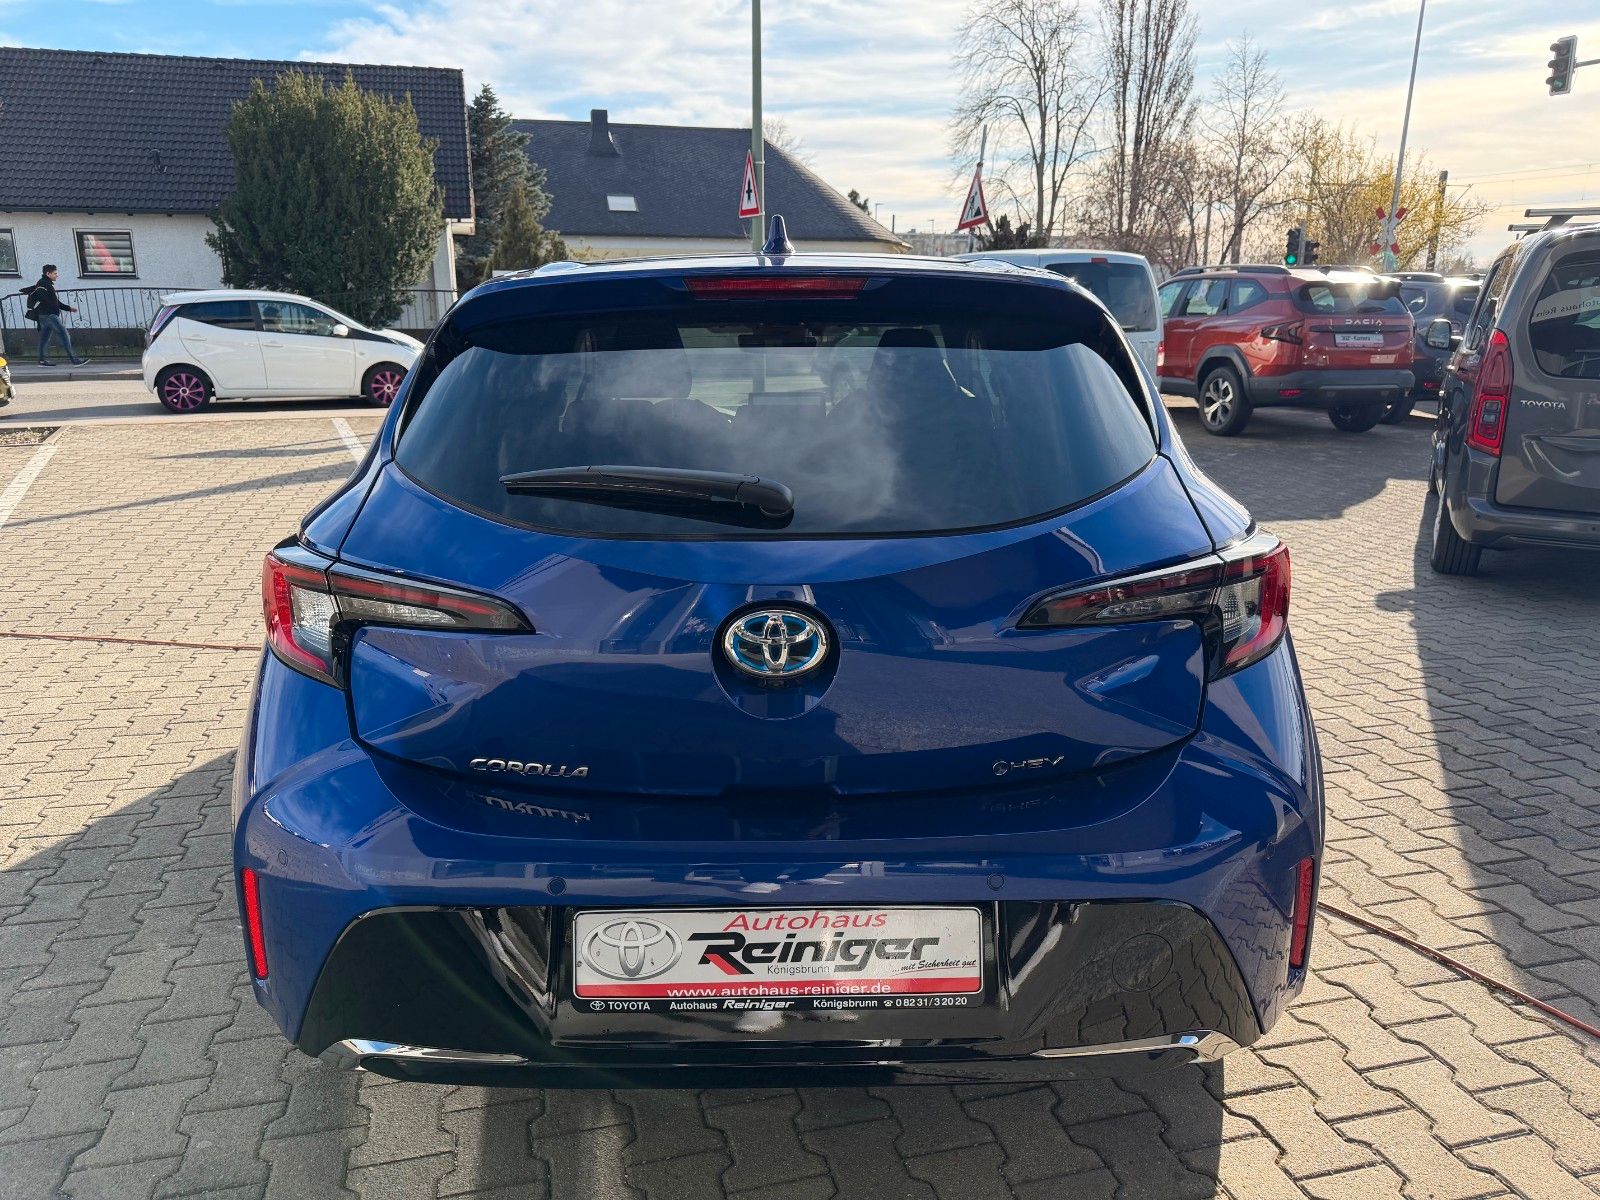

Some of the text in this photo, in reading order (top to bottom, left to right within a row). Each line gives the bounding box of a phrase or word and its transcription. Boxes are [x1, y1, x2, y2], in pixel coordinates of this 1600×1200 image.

[1520, 400, 1566, 410] TOYOTA
[469, 757, 589, 778] COROLLA
[723, 911, 887, 932] Autohaus
[688, 932, 940, 976] Reiniger
[767, 963, 830, 976] Königsbrunn
[918, 959, 960, 970] Sicherheit
[961, 959, 977, 969] gut
[667, 984, 891, 996] www.autohaus-reiniger.de
[607, 1002, 650, 1011] TOYOTA
[669, 1001, 718, 1011] Autohaus
[722, 999, 795, 1010] Reiniger
[813, 998, 878, 1010] Königsbrunn
